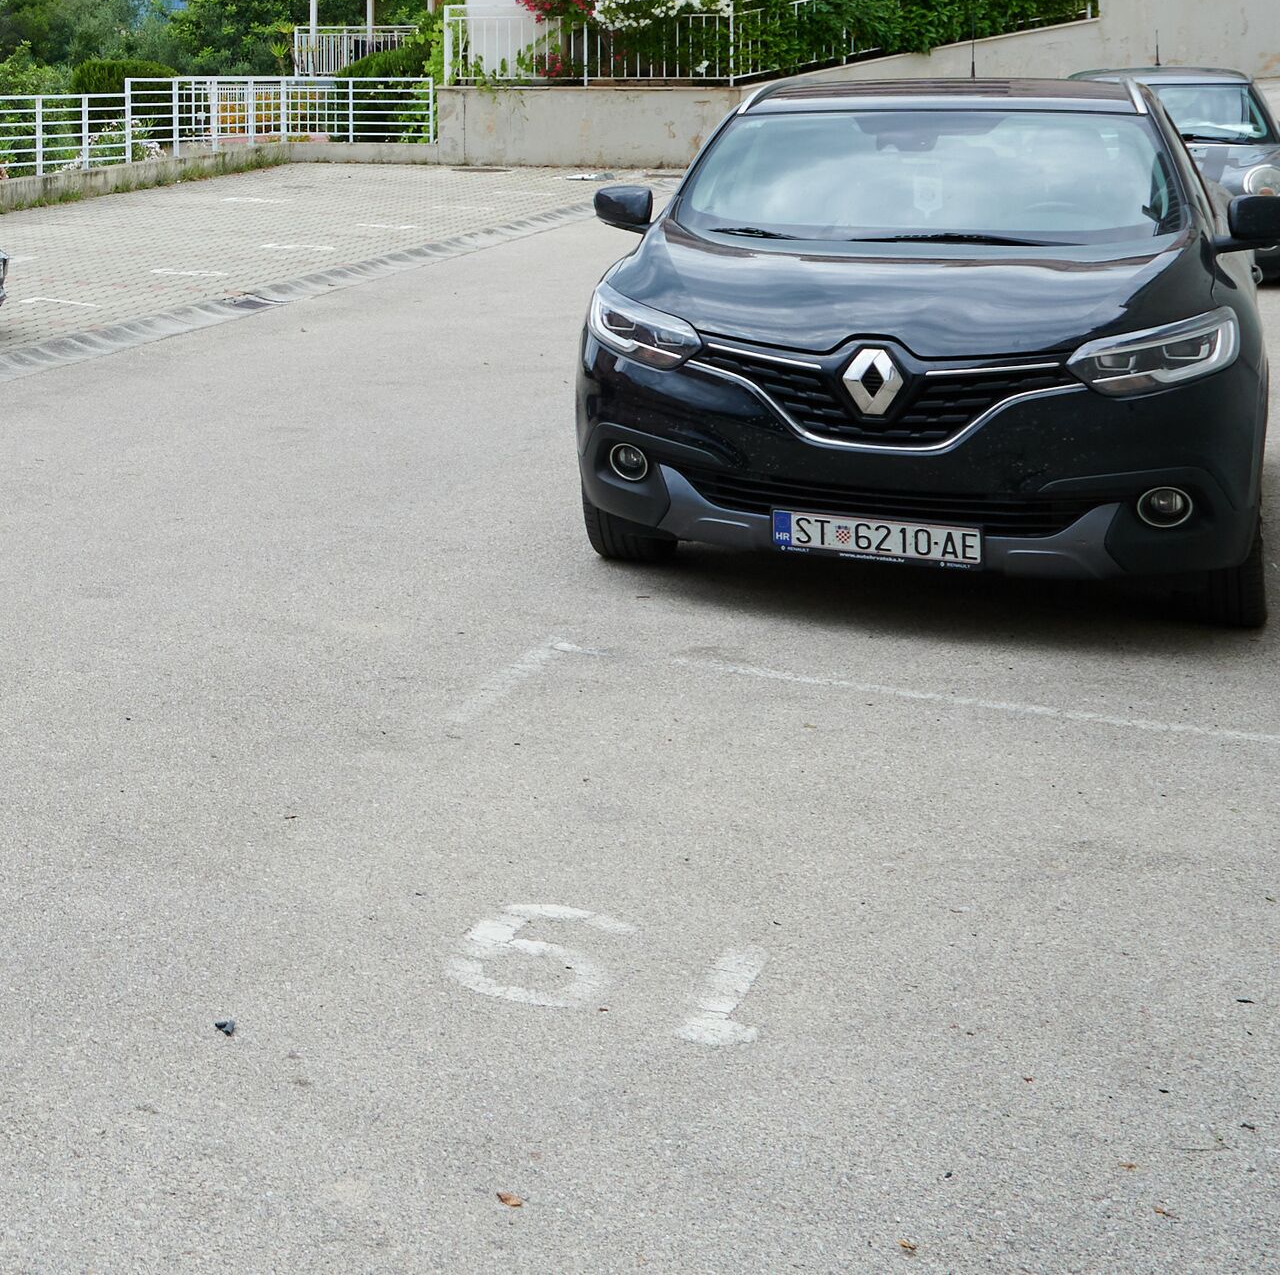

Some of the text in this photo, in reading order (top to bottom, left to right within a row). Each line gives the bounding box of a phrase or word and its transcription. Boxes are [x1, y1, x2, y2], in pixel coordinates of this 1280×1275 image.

[775, 532, 790, 541] HR
[795, 517, 978, 560] ST 6210-AE
